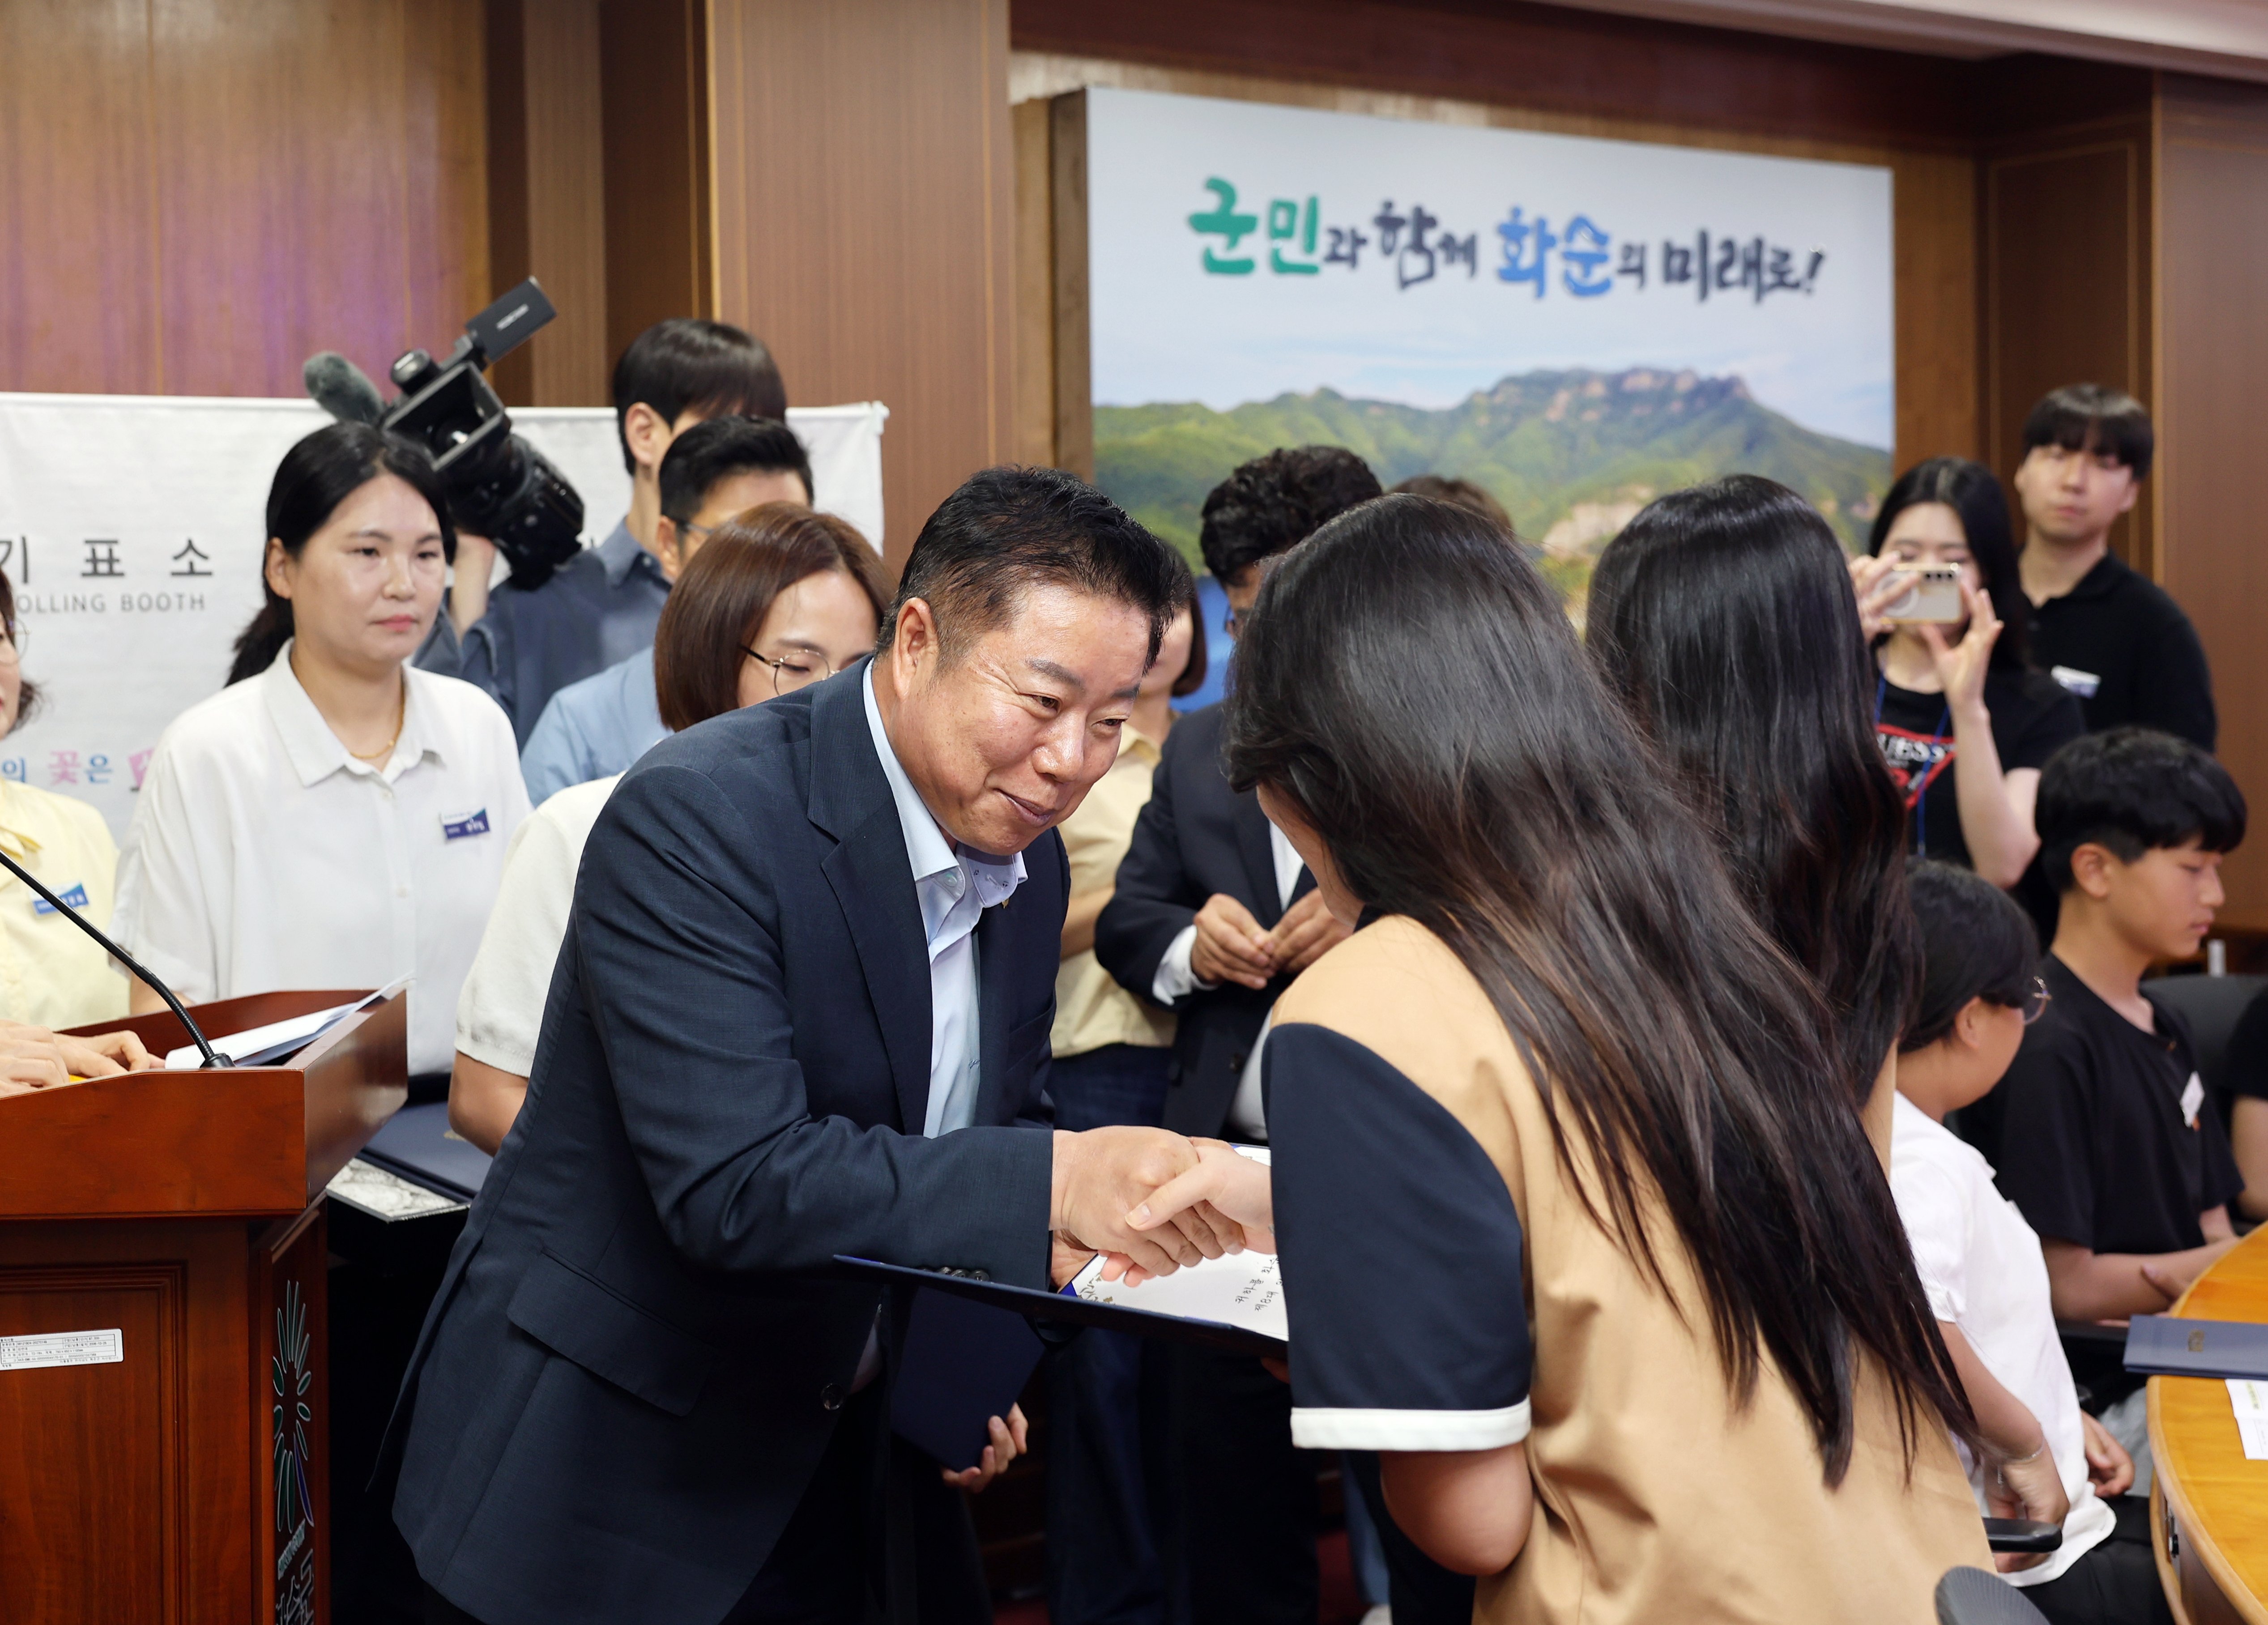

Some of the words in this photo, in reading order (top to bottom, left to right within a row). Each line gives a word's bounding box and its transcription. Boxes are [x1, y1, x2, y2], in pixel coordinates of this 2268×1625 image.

[1187, 177, 1368, 274] 군민과
[1373, 198, 1478, 291] 함께
[1496, 206, 1648, 301] 화순의
[1662, 226, 1827, 305] 미래로!
[16, 593, 106, 614] OLLING
[121, 593, 205, 611] BOOTH
[1878, 734, 1946, 763] UESS
[48, 751, 113, 785] 꽃은
